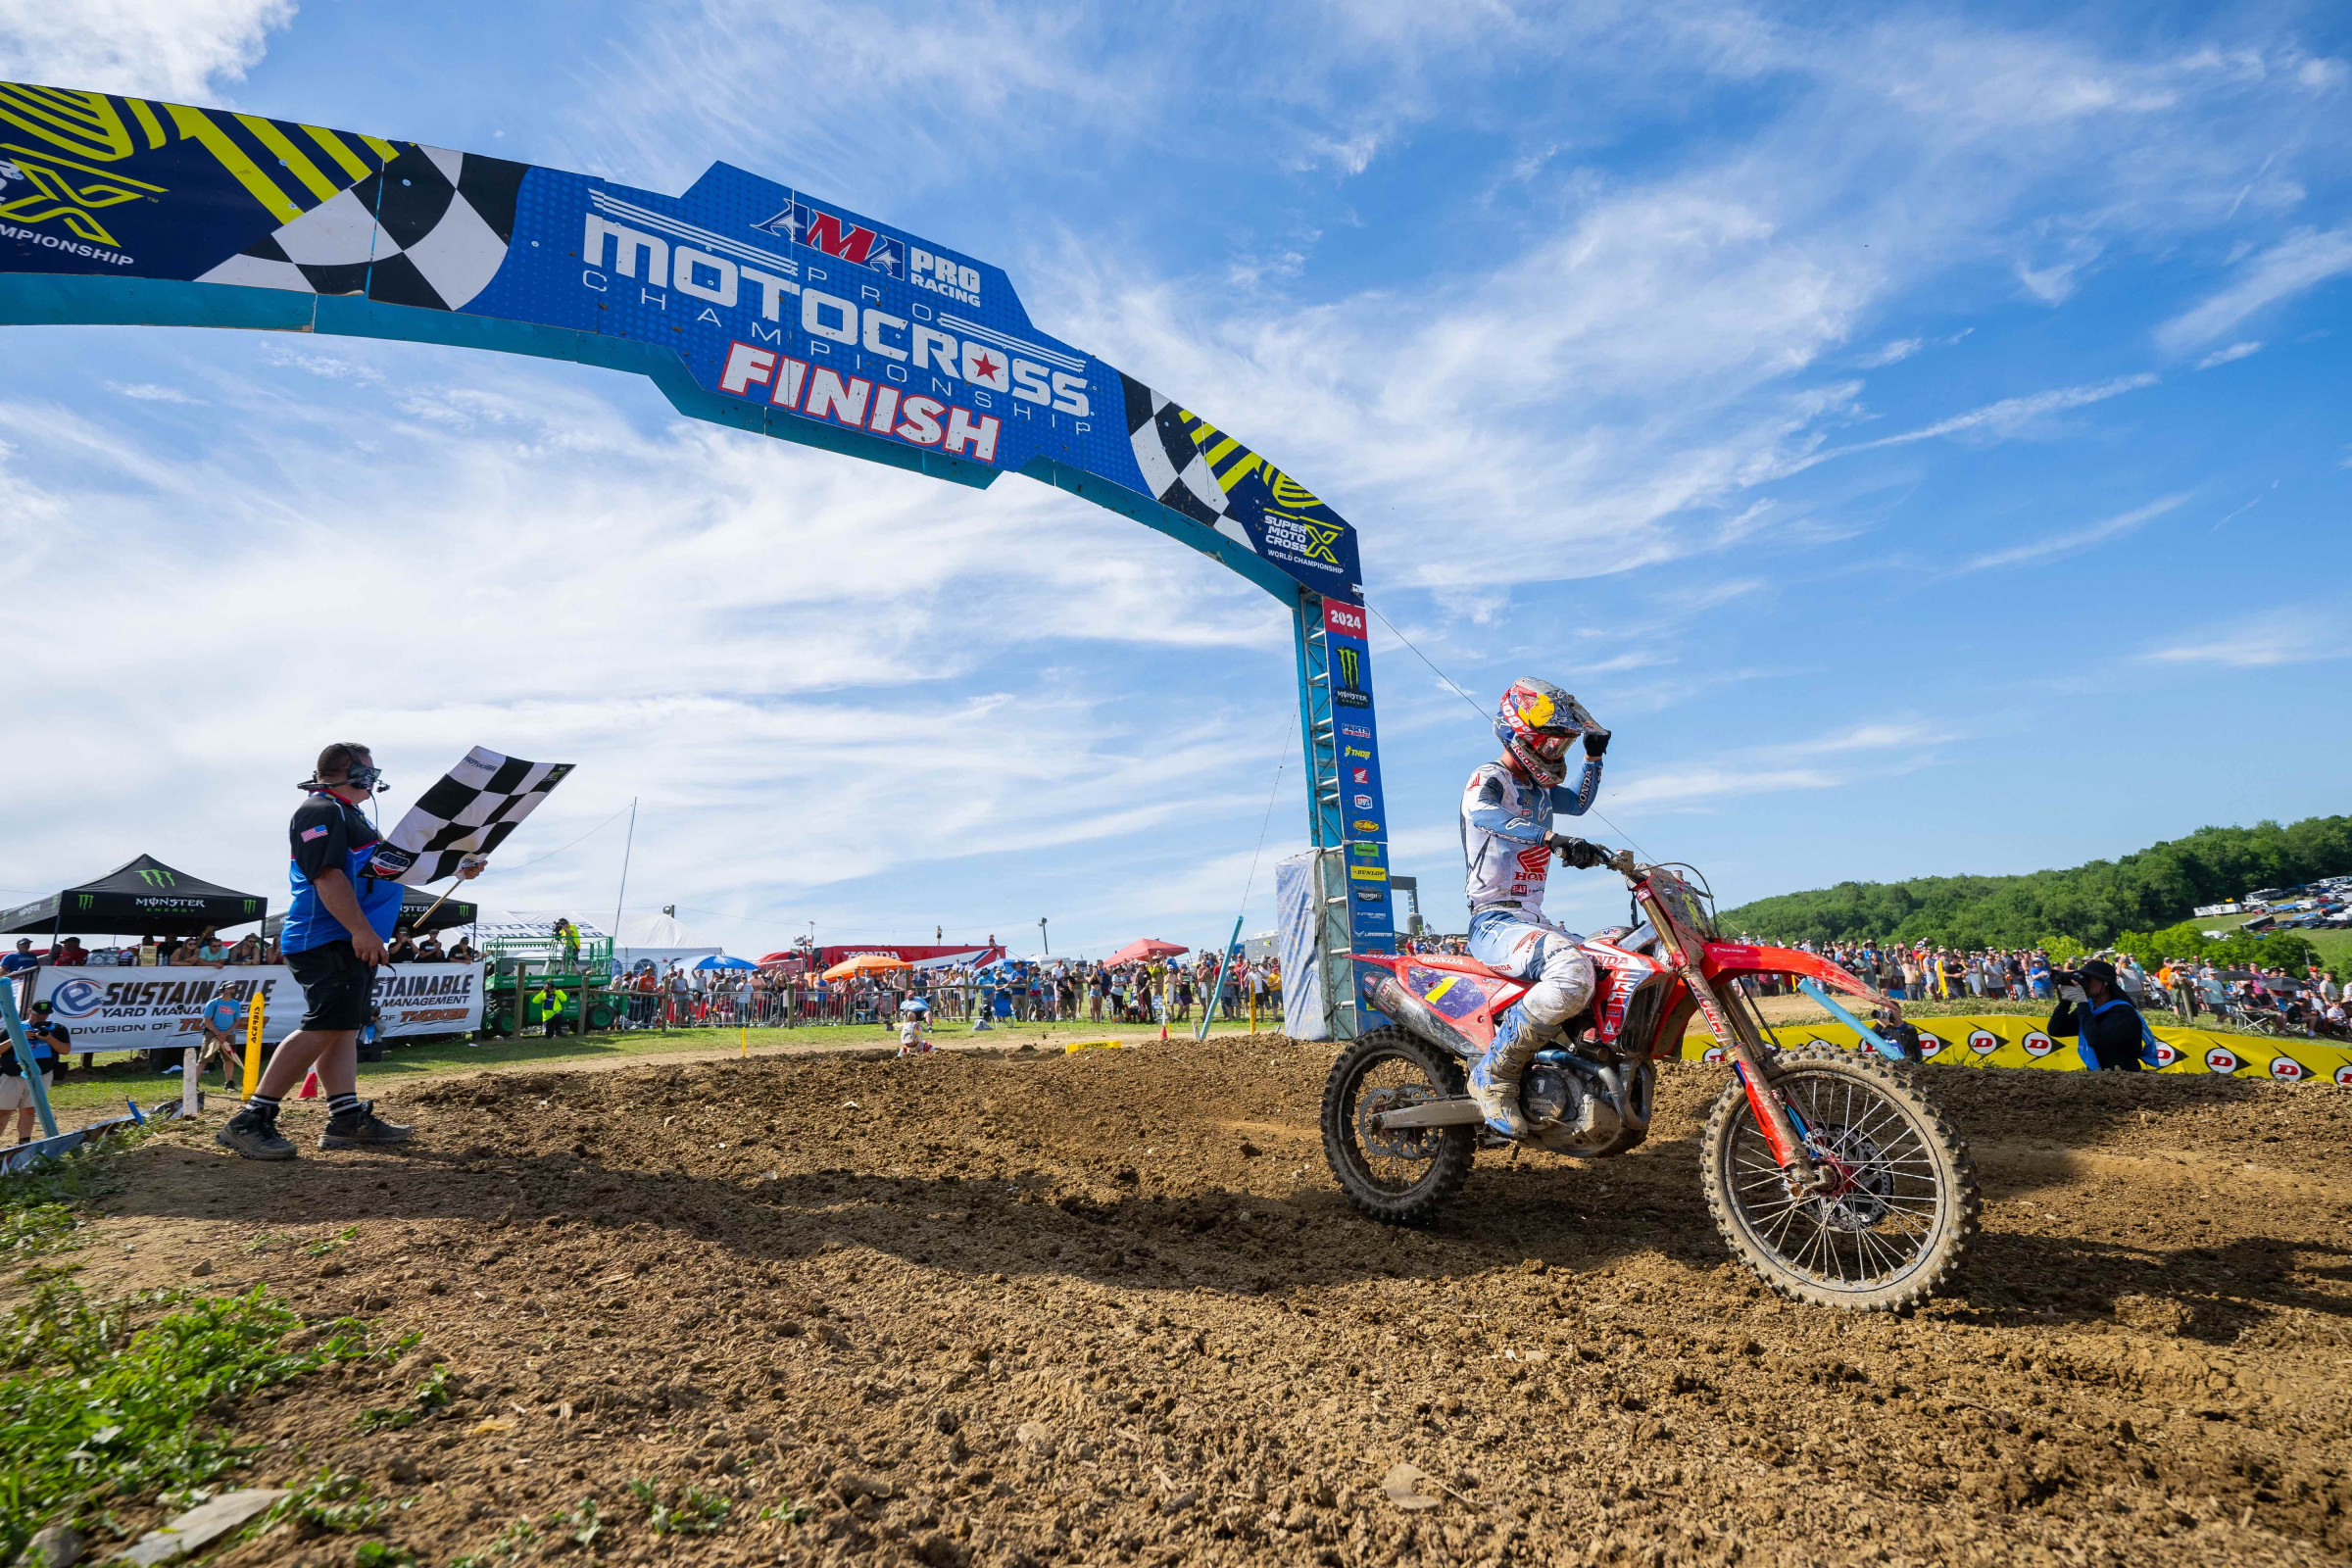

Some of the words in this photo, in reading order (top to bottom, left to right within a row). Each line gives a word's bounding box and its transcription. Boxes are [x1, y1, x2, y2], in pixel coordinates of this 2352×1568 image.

[750, 198, 905, 281] AMA
[910, 246, 981, 294] PRO
[808, 266, 932, 321] PRO
[910, 271, 981, 308] RACING
[583, 213, 1089, 418] MOTOCROSS
[582, 270, 1091, 435] CHAMPIONSHIP
[718, 339, 1003, 464] FINISH
[1264, 514, 1307, 535] SUPER
[1267, 525, 1306, 544] MOTO
[1265, 534, 1307, 553] CROSS
[1267, 549, 1293, 562] WORLD
[1294, 556, 1344, 574] CHAMPIONSHIP
[1331, 610, 1361, 629] 2024
[1337, 690, 1368, 703] MONSTER
[1351, 749, 1371, 759] THOR
[135, 897, 206, 908] MONSTER
[1421, 956, 1463, 965] HONDA
[1425, 975, 1461, 1004] 1
[380, 996, 470, 1007] MANAGEMENT
[101, 1006, 147, 1018] YARD
[400, 1007, 470, 1023] TUCKER
[71, 1024, 146, 1035] DIVISION
[250, 1006, 261, 1044] ACERBIS
[1920, 1039, 1937, 1050] D
[1973, 1037, 1993, 1048] D
[2027, 1038, 2049, 1049] D
[2156, 1049, 2172, 1060] D
[2209, 1054, 2233, 1067] D
[2275, 1063, 2299, 1076] D
[1538, 1079, 1545, 1094] 1
